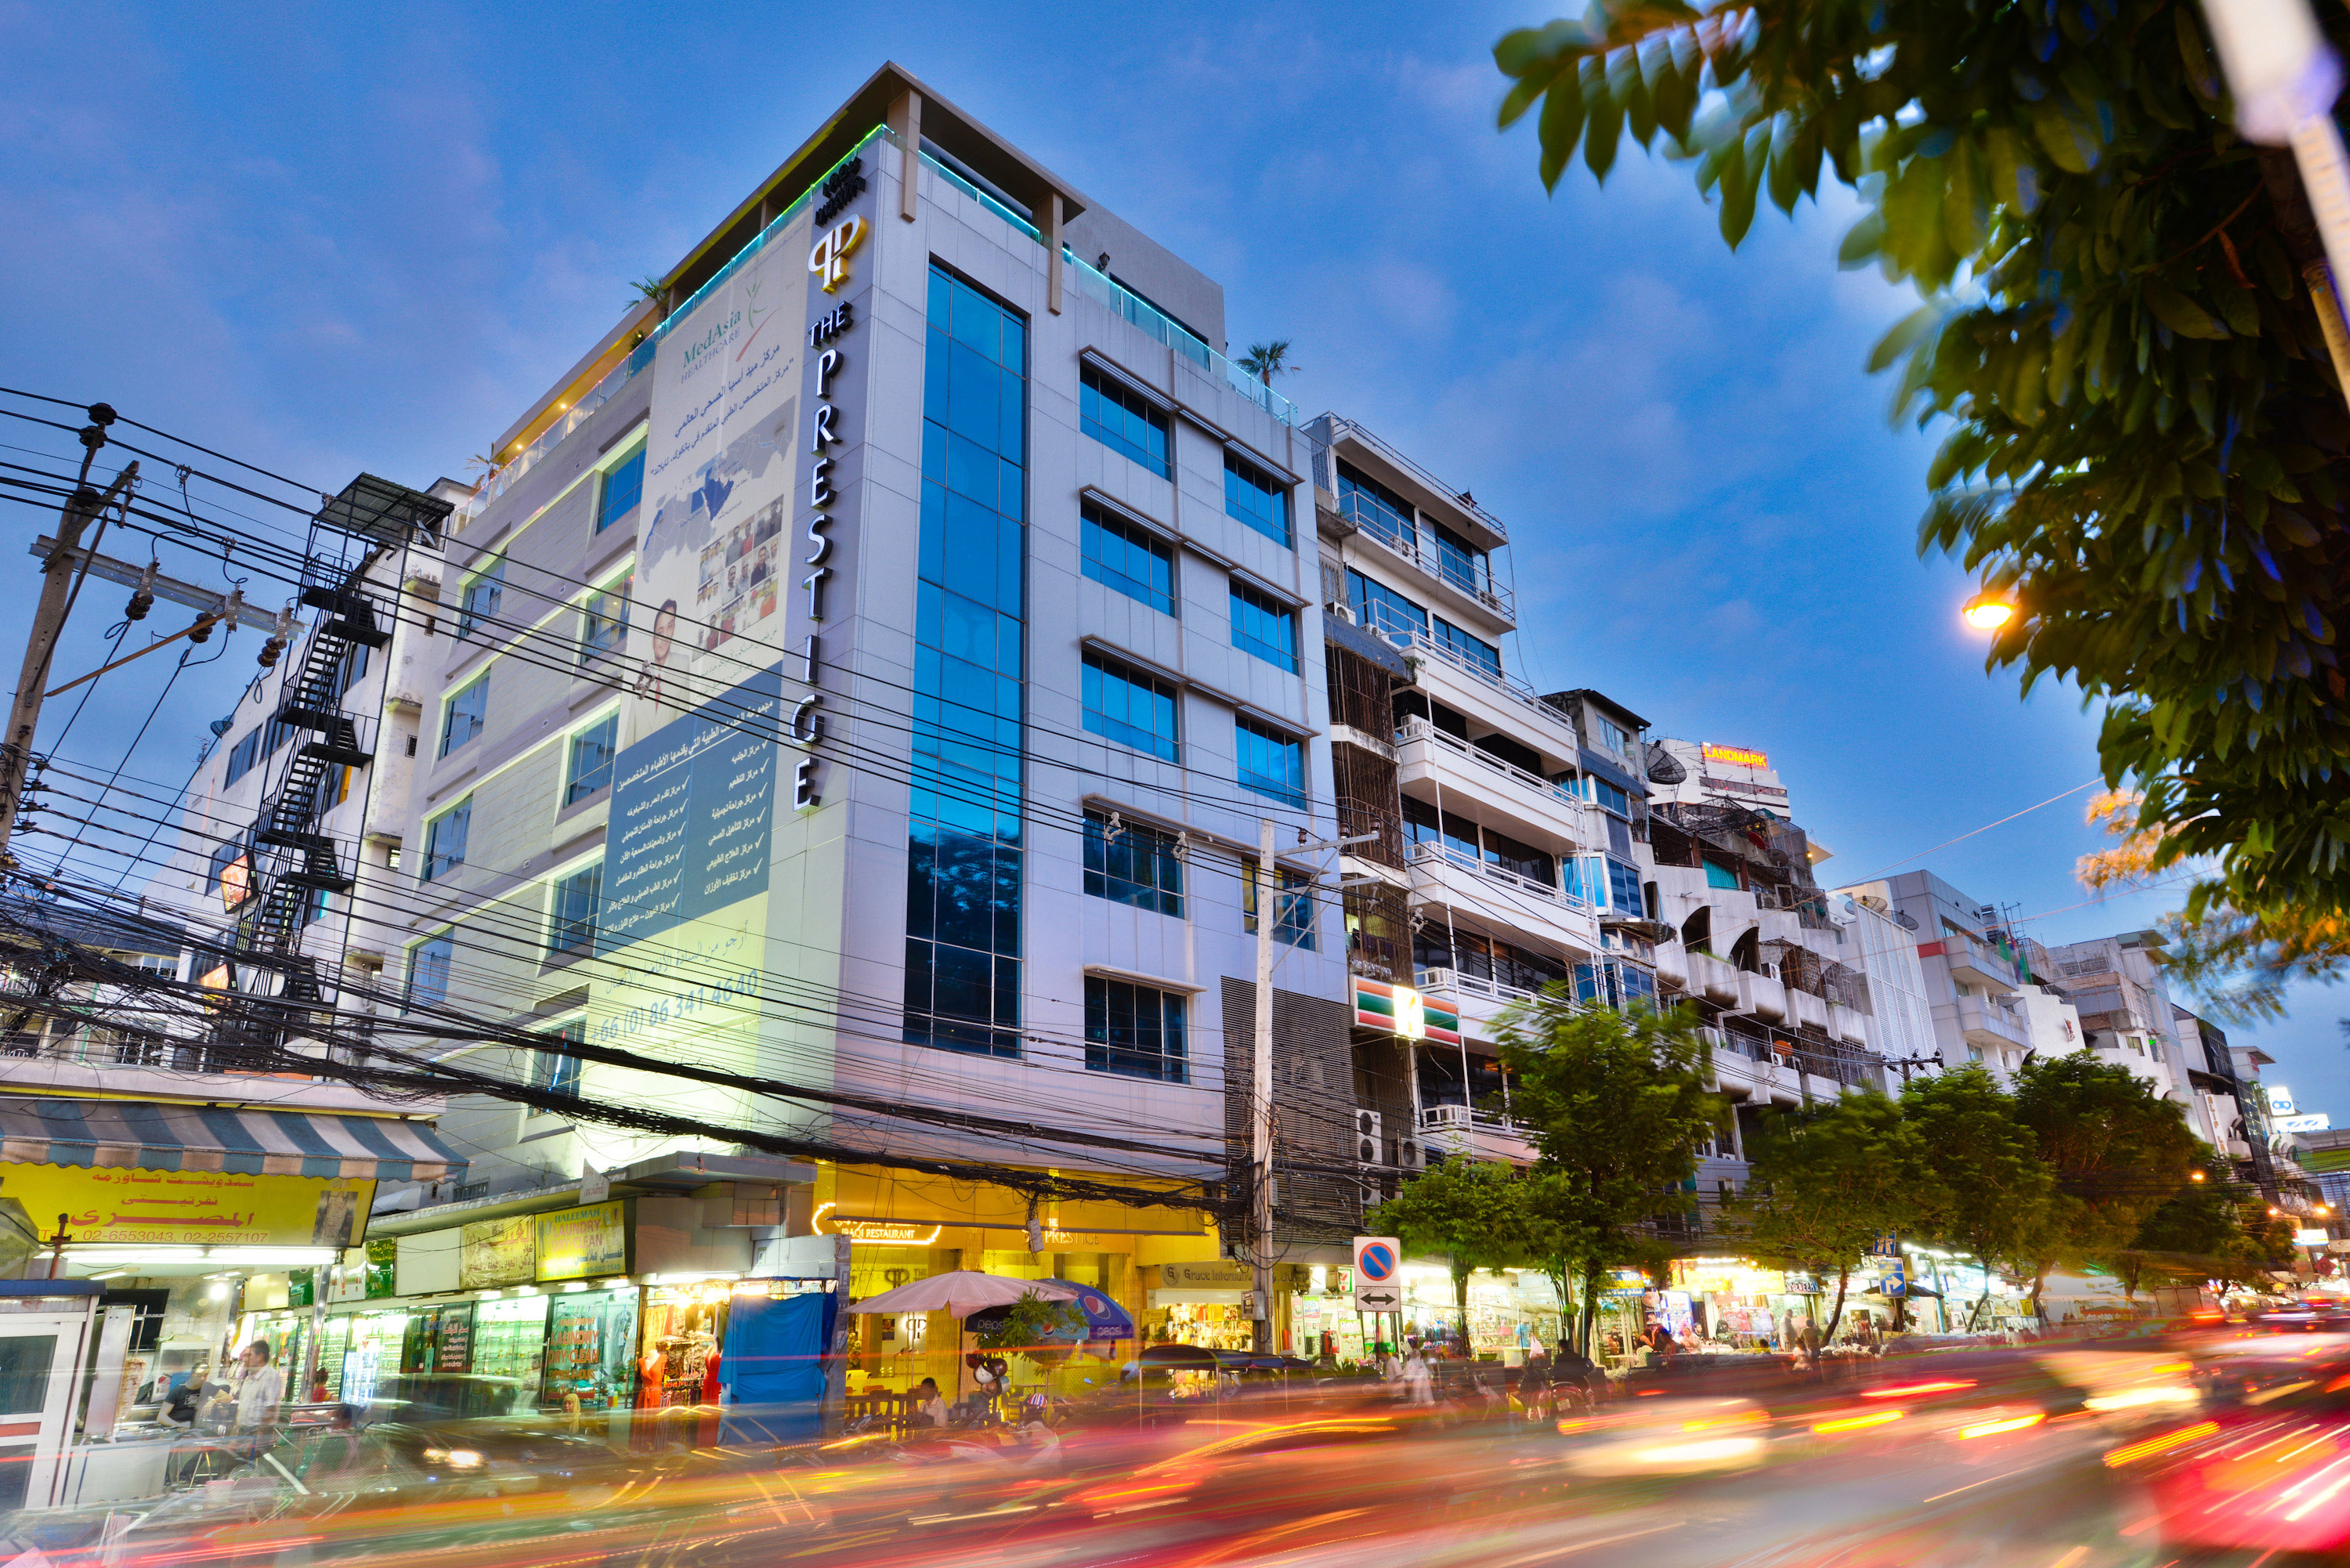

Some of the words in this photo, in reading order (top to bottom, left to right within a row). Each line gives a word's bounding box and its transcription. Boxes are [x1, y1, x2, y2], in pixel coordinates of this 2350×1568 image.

[808, 301, 852, 350] THE
[683, 311, 740, 368] MedAsia
[682, 327, 739, 384] HEALTHCARE
[761, 345, 779, 367] مركز
[746, 363, 757, 377] ميد
[739, 376, 772, 410] المتخصص
[701, 386, 725, 417] الصحي
[721, 403, 738, 425] الطبي
[674, 407, 699, 438] العالمي
[701, 417, 720, 440] المتقدم
[692, 431, 700, 448] في
[790, 348, 844, 812] PRESTIGE
[746, 700, 772, 717] مجموعة
[720, 711, 744, 733] الخدمات
[701, 725, 719, 745] الطبية
[670, 743, 688, 762] يقدمها
[688, 735, 700, 754] التي
[747, 745, 759, 757] مركز
[650, 753, 668, 771] الأطباء
[1704, 746, 1766, 767] LANDMARK
[616, 764, 649, 792] المتخصصين
[728, 772, 745, 790] التطعيم
[745, 769, 757, 781] مركز
[660, 788, 670, 802] تقدم
[669, 786, 680, 797] مركز
[743, 793, 756, 805] مركز
[649, 793, 660, 807] العمر
[727, 799, 743, 811] جراحة
[653, 814, 667, 824] جراحة
[667, 808, 678, 819] مركز
[711, 804, 728, 819] تجميلية
[637, 818, 653, 834] الأسنان
[742, 817, 754, 829] مركز
[621, 826, 638, 844] التجميلي
[664, 831, 676, 842] مركز
[707, 828, 725, 846] الصحي
[630, 843, 646, 858] السمعية
[724, 847, 739, 863] العلاج
[739, 843, 753, 855] مركز
[649, 859, 663, 869] جراحة
[663, 854, 674, 865] مركز
[706, 853, 724, 871] الطبيعي
[615, 871, 632, 887] المفاصل
[635, 863, 649, 879] العظام
[721, 871, 738, 885] تخفيف
[738, 869, 750, 880] مركز
[649, 881, 660, 894] الطب
[660, 878, 672, 890] مركز
[704, 878, 721, 894] الأوزان
[634, 886, 649, 902] الصيني
[658, 901, 670, 913] مركز
[628, 914, 638, 927] علاج
[704, 942, 718, 963] من
[591, 1016, 619, 1044] +66
[624, 1006, 645, 1038] (0)
[649, 999, 668, 1027] 86
[674, 987, 704, 1019] 341
[712, 969, 758, 1006] 4640
[555, 1209, 600, 1223] HALEEMAH
[1048, 1218, 1058, 1227] THE
[553, 1219, 601, 1237] LAUNDRY
[842, 1228, 864, 1239] IRAQI
[866, 1228, 915, 1239] RESTAURANT
[184, 1232, 268, 1243] 02-2557107
[1045, 1230, 1099, 1245] PRESTIGE
[1184, 1269, 1210, 1281] Grace
[978, 1319, 1010, 1331] peps
[1097, 1324, 1122, 1337] pepsi
[551, 1330, 599, 1346] LAUNDRY
[548, 1349, 599, 1364] DRY-CLEAN
